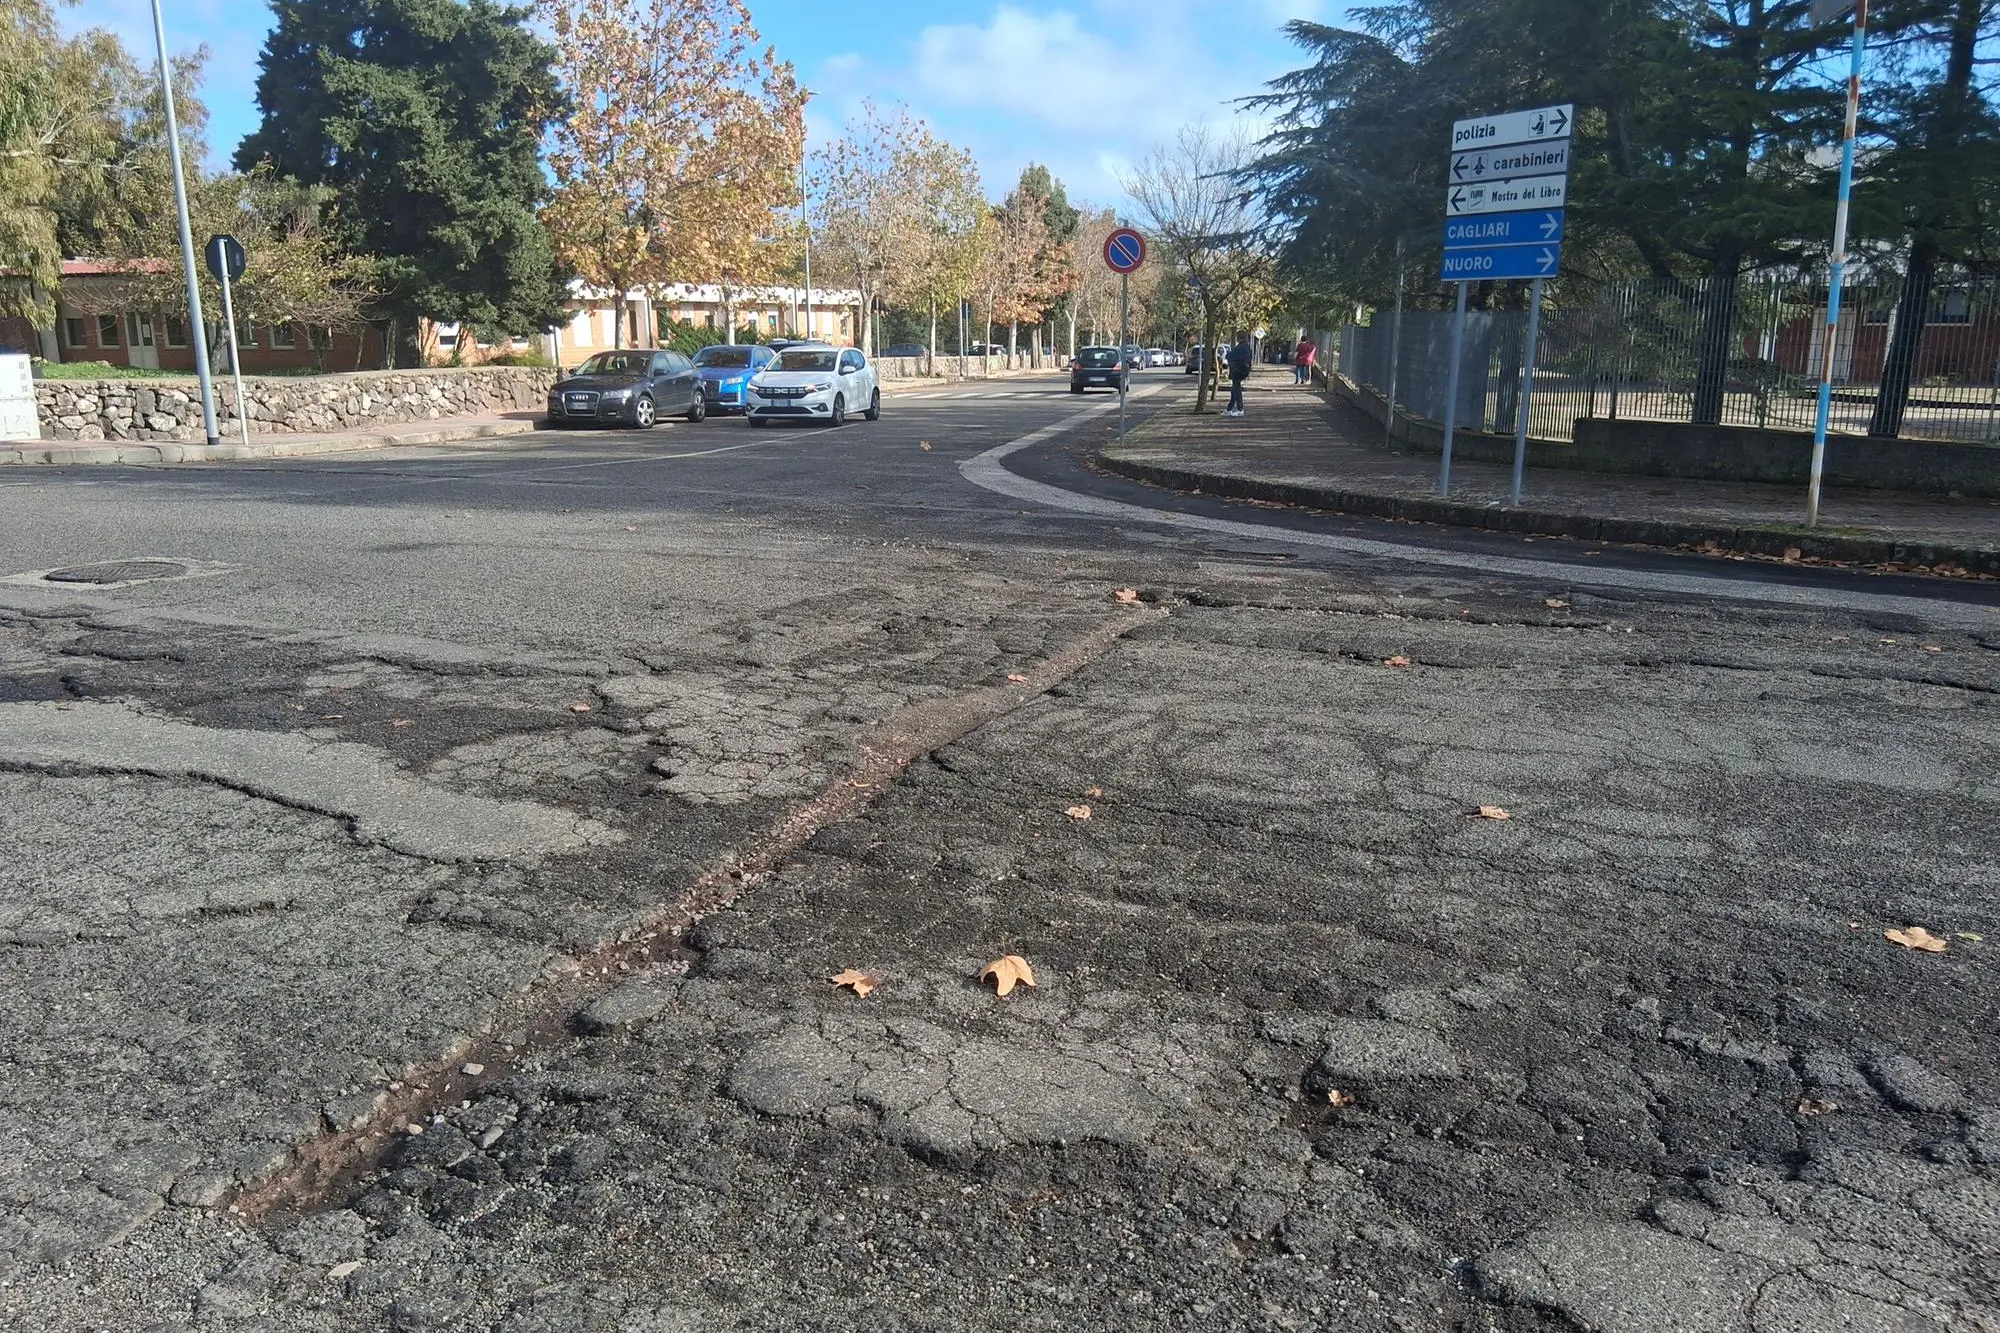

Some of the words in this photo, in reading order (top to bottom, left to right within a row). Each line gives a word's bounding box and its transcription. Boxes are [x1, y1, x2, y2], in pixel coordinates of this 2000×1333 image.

[1456, 124, 1496, 144] polizia
[1494, 150, 1564, 170] carabinieri
[1492, 191, 1518, 202] Mostra
[1522, 188, 1535, 200] del
[1448, 222, 1510, 238] CAGLIARI
[1444, 256, 1492, 272] NUORO
